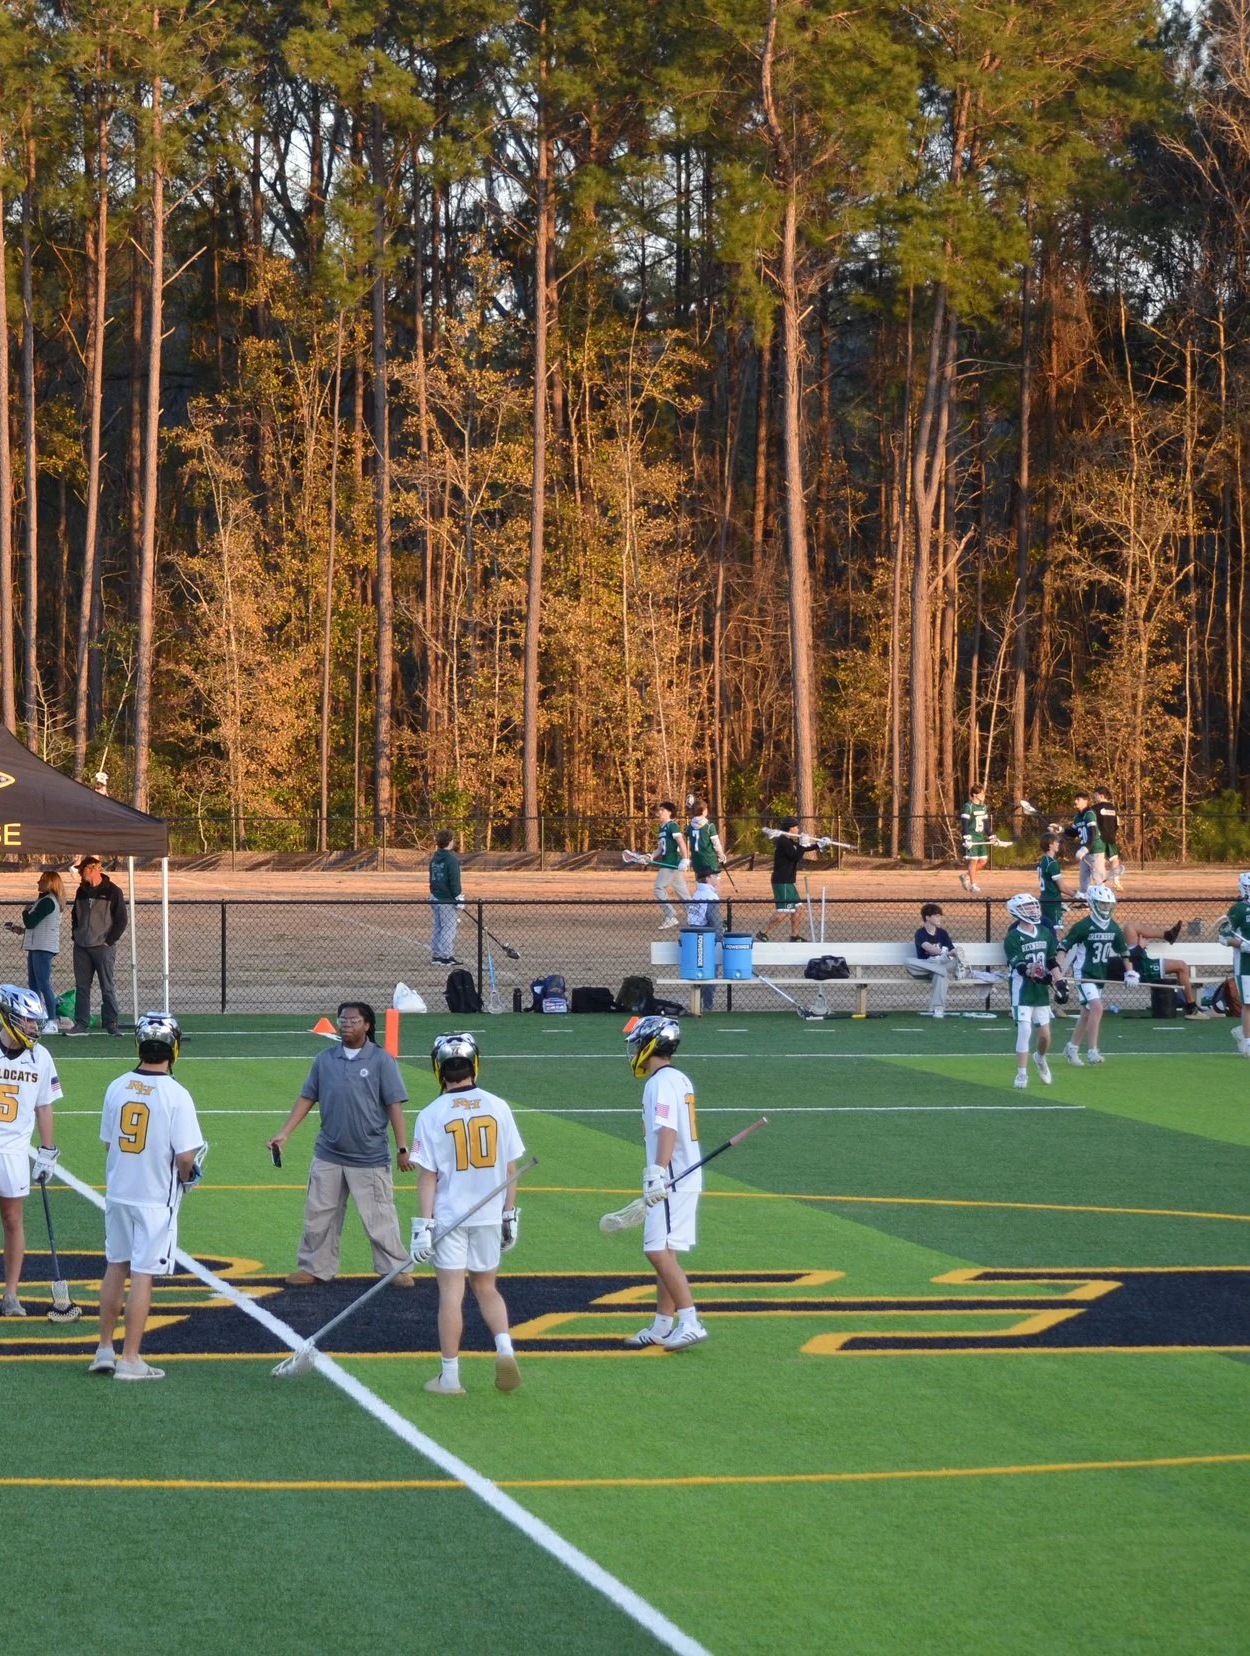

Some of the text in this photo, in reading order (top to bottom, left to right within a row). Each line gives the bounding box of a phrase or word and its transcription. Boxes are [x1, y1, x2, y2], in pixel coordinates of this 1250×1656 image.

[691, 829, 700, 852] 7
[1092, 941, 1112, 964] 30
[118, 1101, 151, 1154] 9
[444, 1114, 498, 1171] 10
